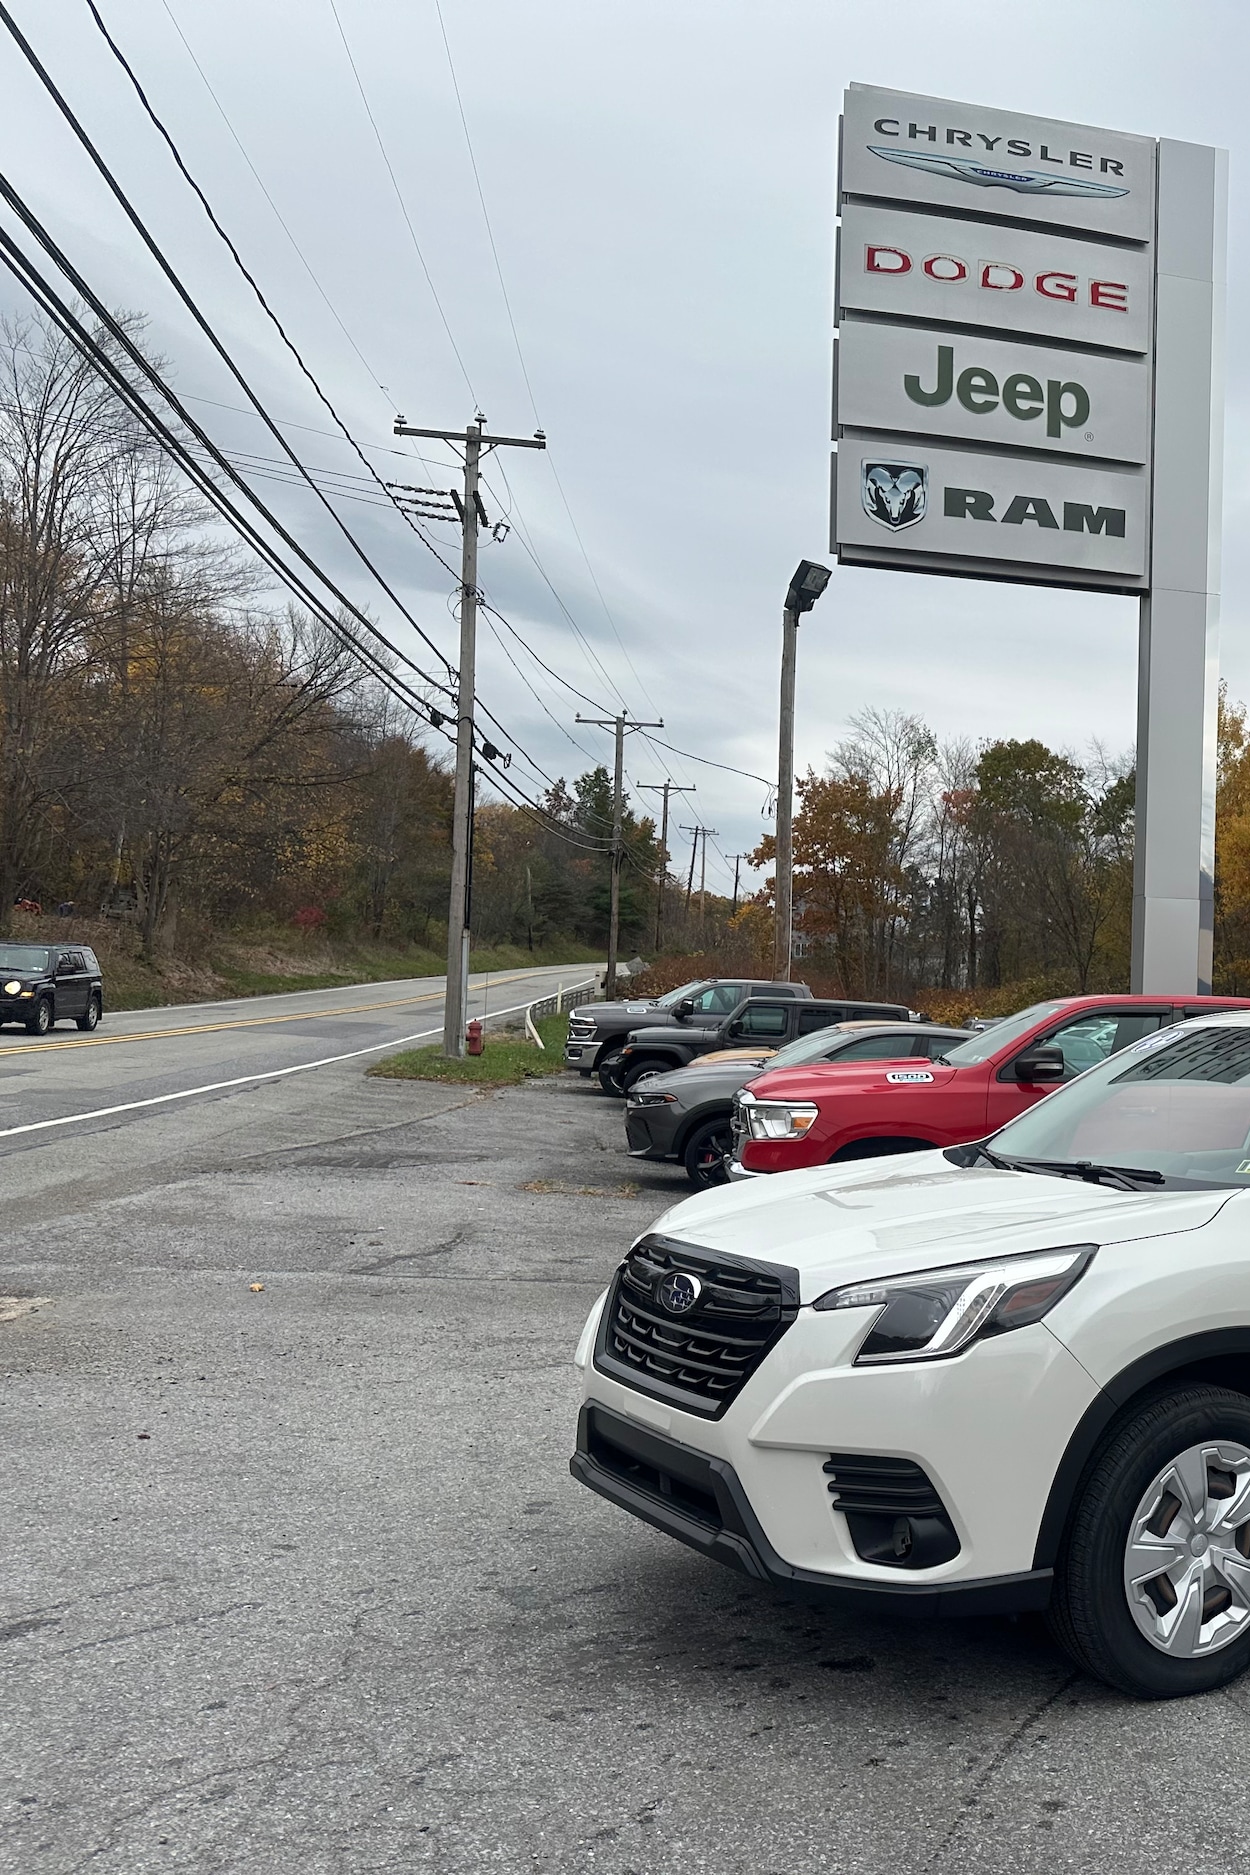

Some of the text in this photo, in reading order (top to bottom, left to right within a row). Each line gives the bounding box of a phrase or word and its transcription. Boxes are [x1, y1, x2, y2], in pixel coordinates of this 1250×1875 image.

[873, 118, 1124, 176] CHRYSLER
[976, 168, 1028, 182] CHRYSLER
[864, 243, 1129, 314] DODGE
[904, 345, 1090, 439] Jeep
[944, 486, 1126, 538] RAM
